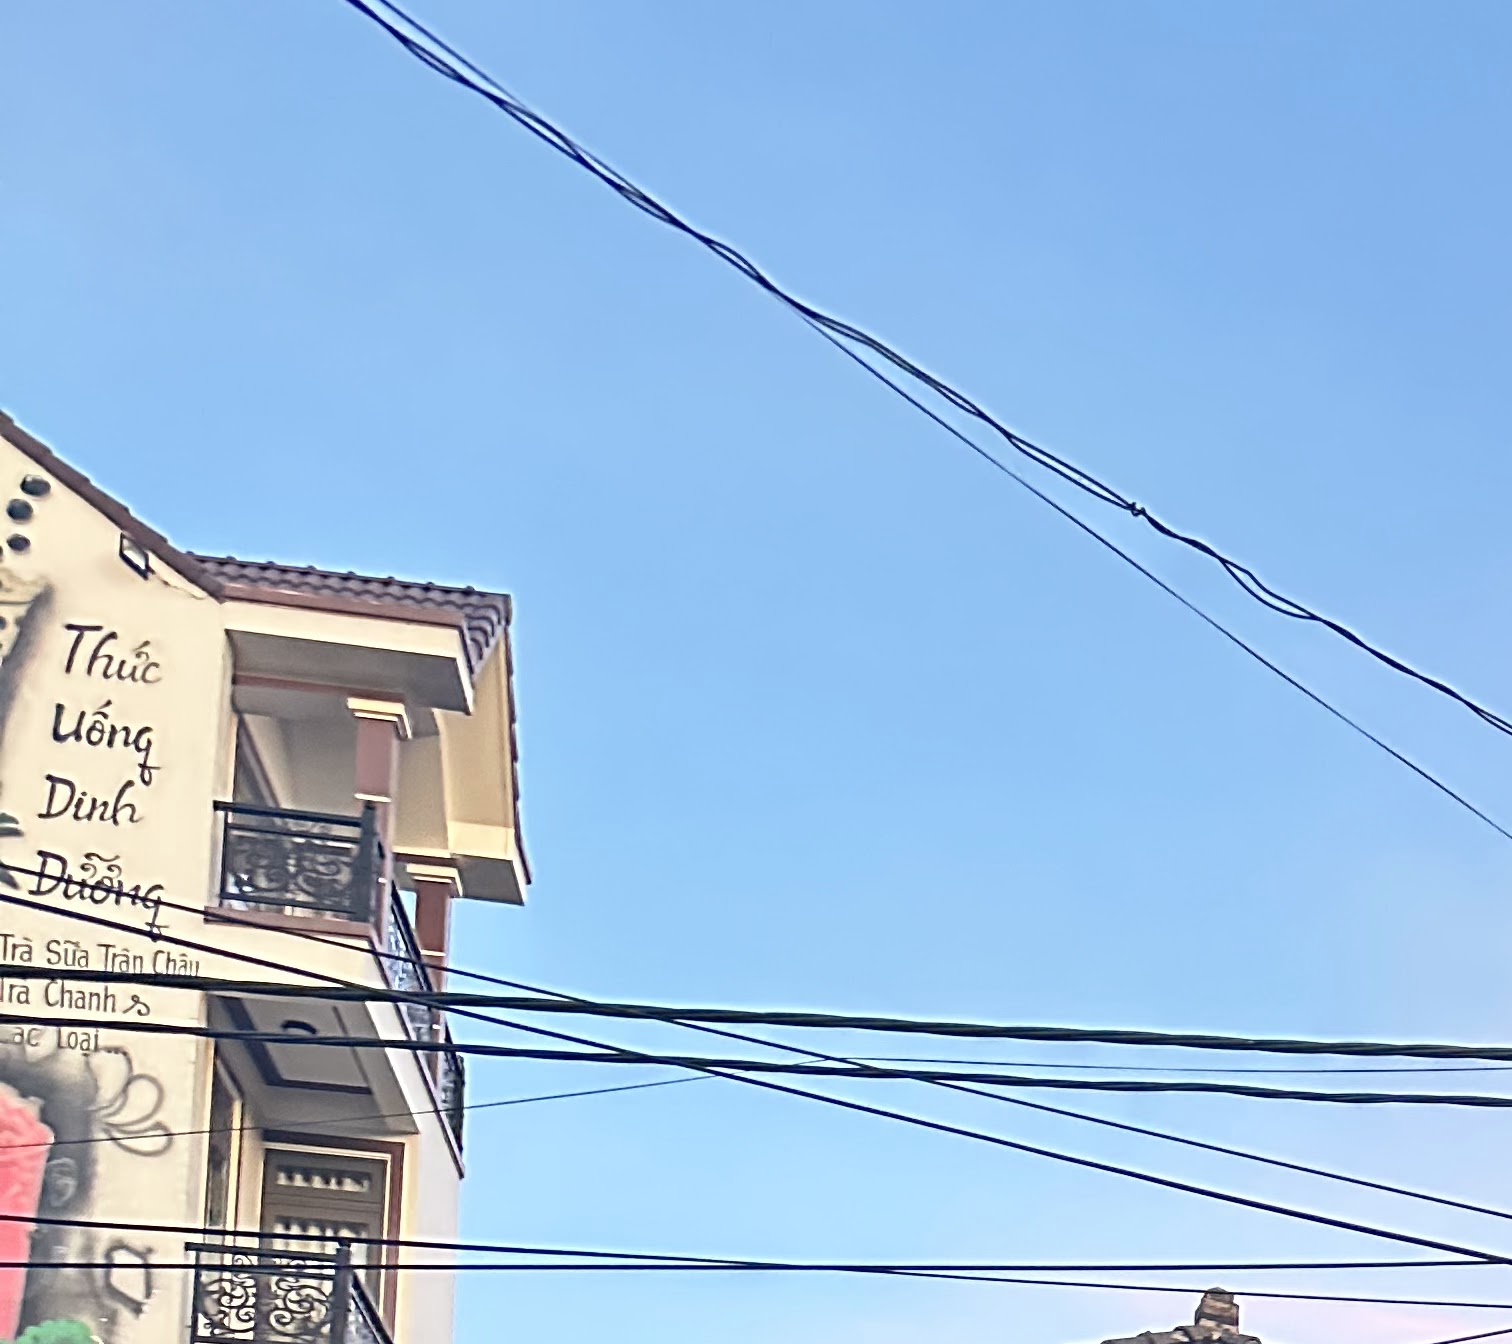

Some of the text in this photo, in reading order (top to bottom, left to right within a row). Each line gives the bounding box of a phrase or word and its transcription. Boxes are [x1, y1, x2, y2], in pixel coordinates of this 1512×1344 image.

[64, 623, 162, 685] Thức
[52, 700, 160, 785] Uống
[38, 774, 144, 826] Dinh
[46, 939, 89, 969] Sữa
[44, 978, 117, 1014] Chanh
